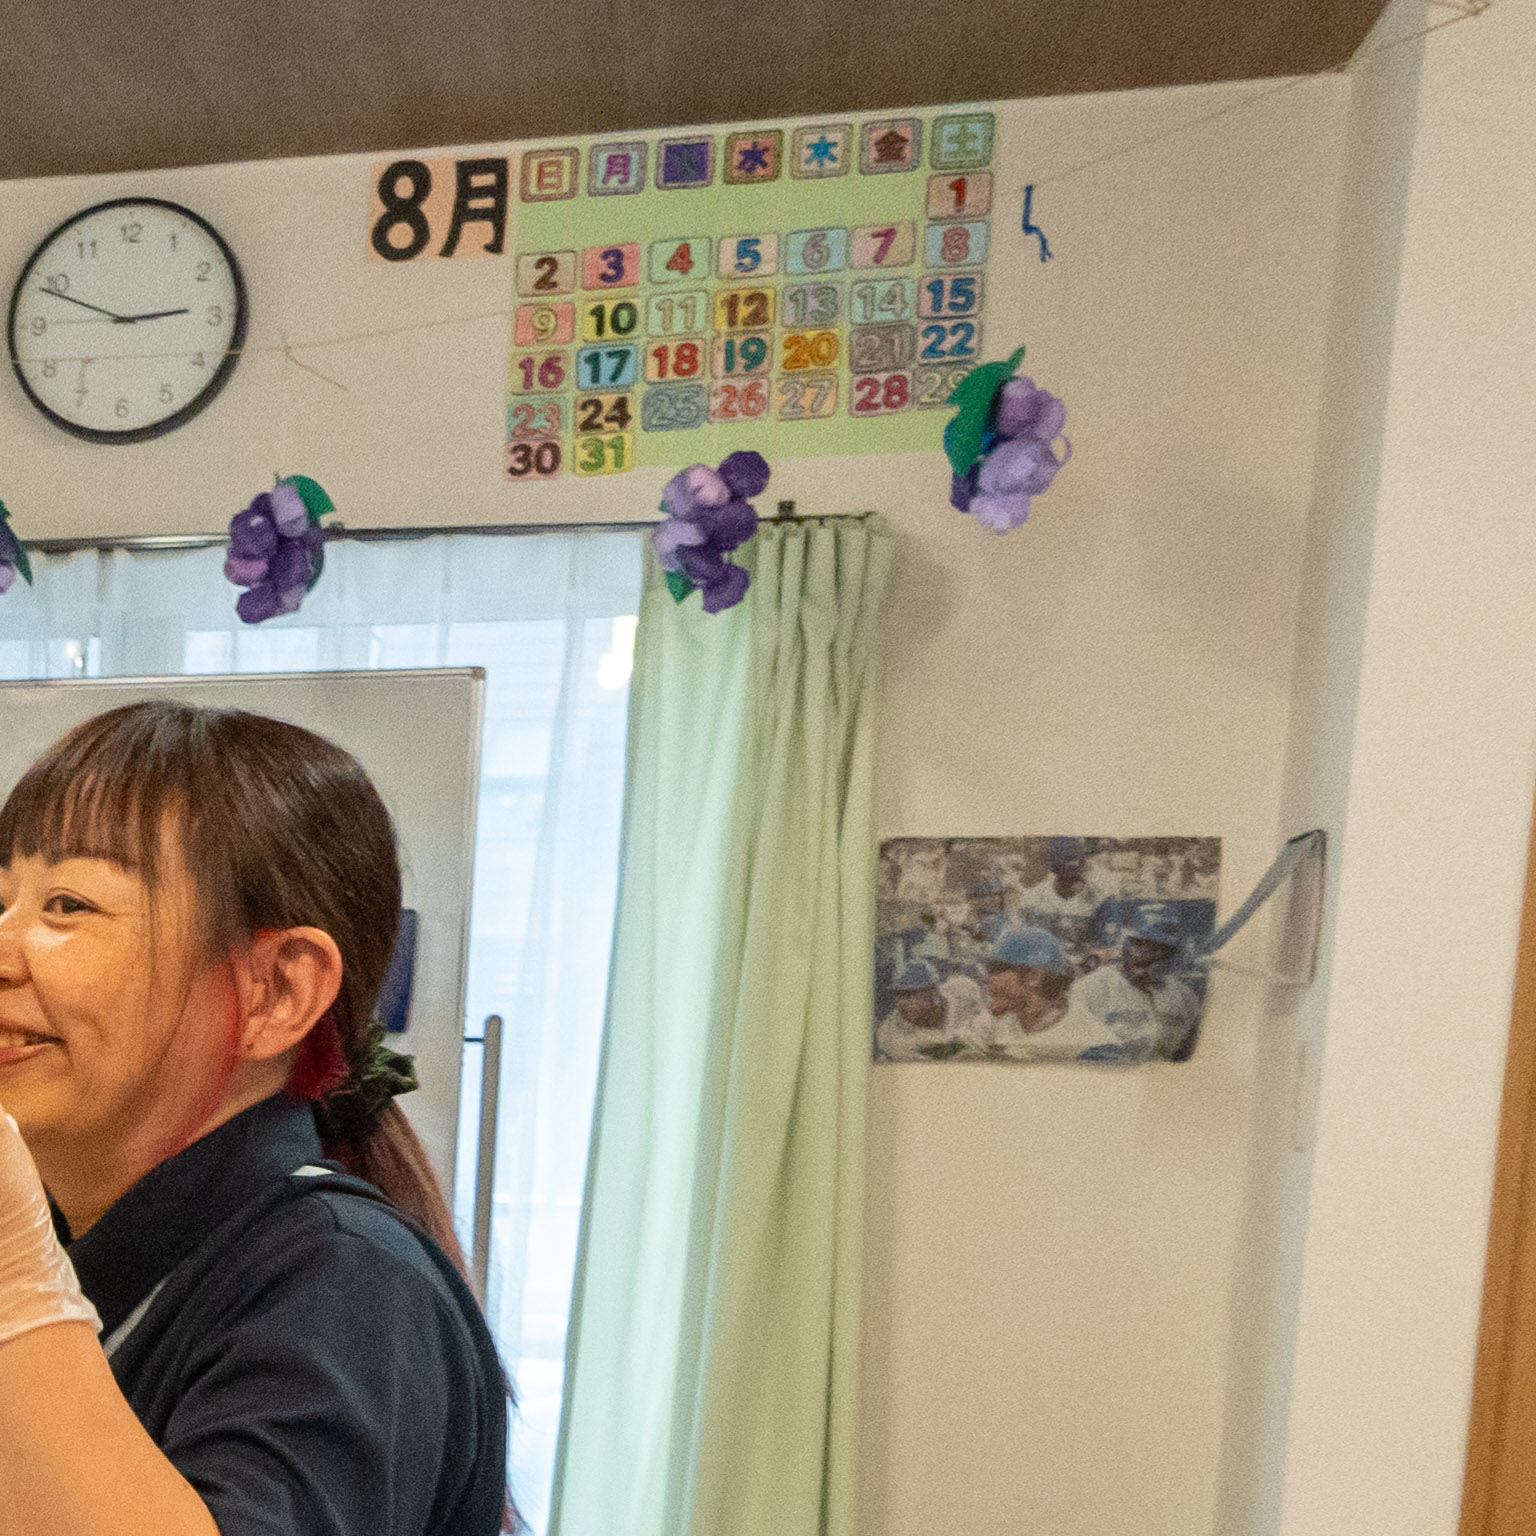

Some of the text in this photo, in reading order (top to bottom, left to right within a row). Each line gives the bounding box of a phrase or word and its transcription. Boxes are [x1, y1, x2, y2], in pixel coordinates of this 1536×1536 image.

[536, 160, 563, 191] 日
[602, 154, 631, 185] 月
[371, 157, 509, 262] 8月
[949, 178, 967, 212] 1
[120, 222, 143, 244] 12
[196, 261, 211, 282] 2
[535, 227, 969, 290] 2 3 4 5 6 7 8
[207, 305, 223, 327] 3
[532, 277, 976, 343] 9 10 11 12 13 14 15
[518, 322, 975, 390] 16 17 18 19 20 21 22
[511, 402, 561, 439] 23
[579, 397, 632, 432] 24
[712, 382, 765, 419] 26
[780, 379, 835, 414] 27
[855, 375, 909, 412] 28
[508, 436, 625, 476] 30 31
